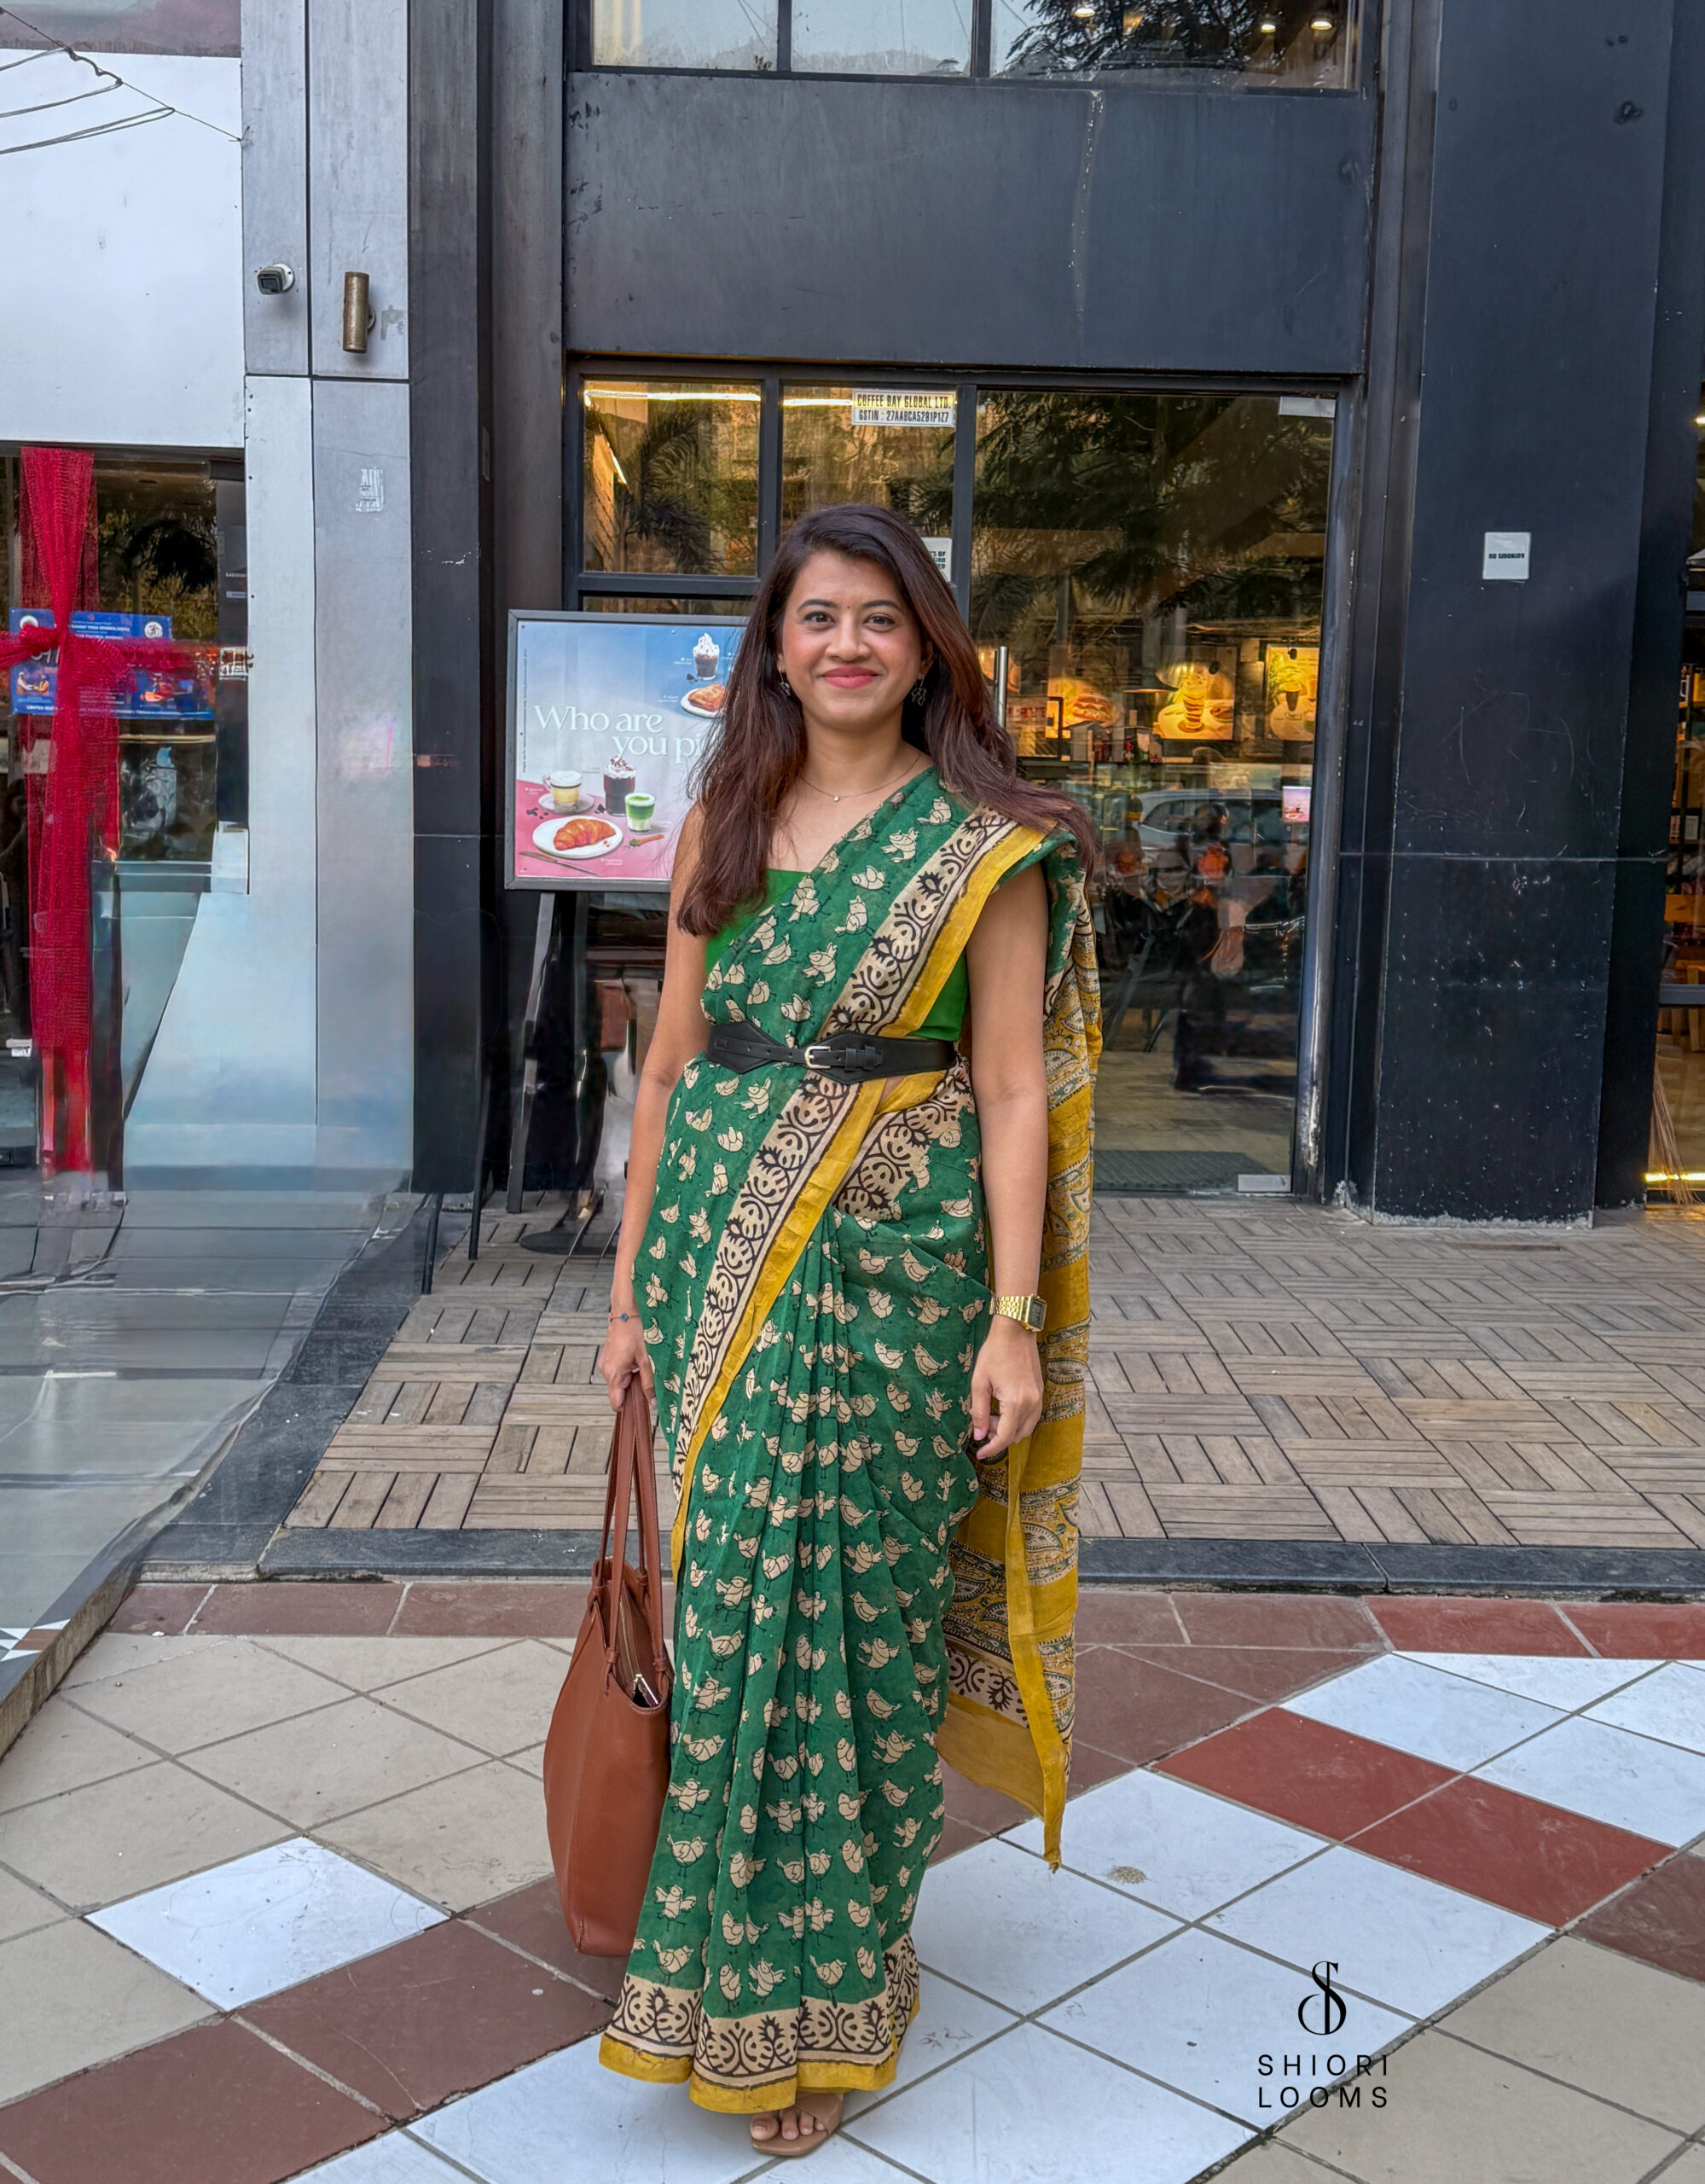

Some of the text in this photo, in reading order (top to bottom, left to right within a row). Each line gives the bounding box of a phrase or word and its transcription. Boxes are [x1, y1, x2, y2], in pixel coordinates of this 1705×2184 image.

[857, 394, 952, 409] COFFEE DAY GLOBAL LTD.
[859, 410, 879, 421] GSTIN
[534, 706, 663, 733] Who are
[612, 736, 668, 759] you
